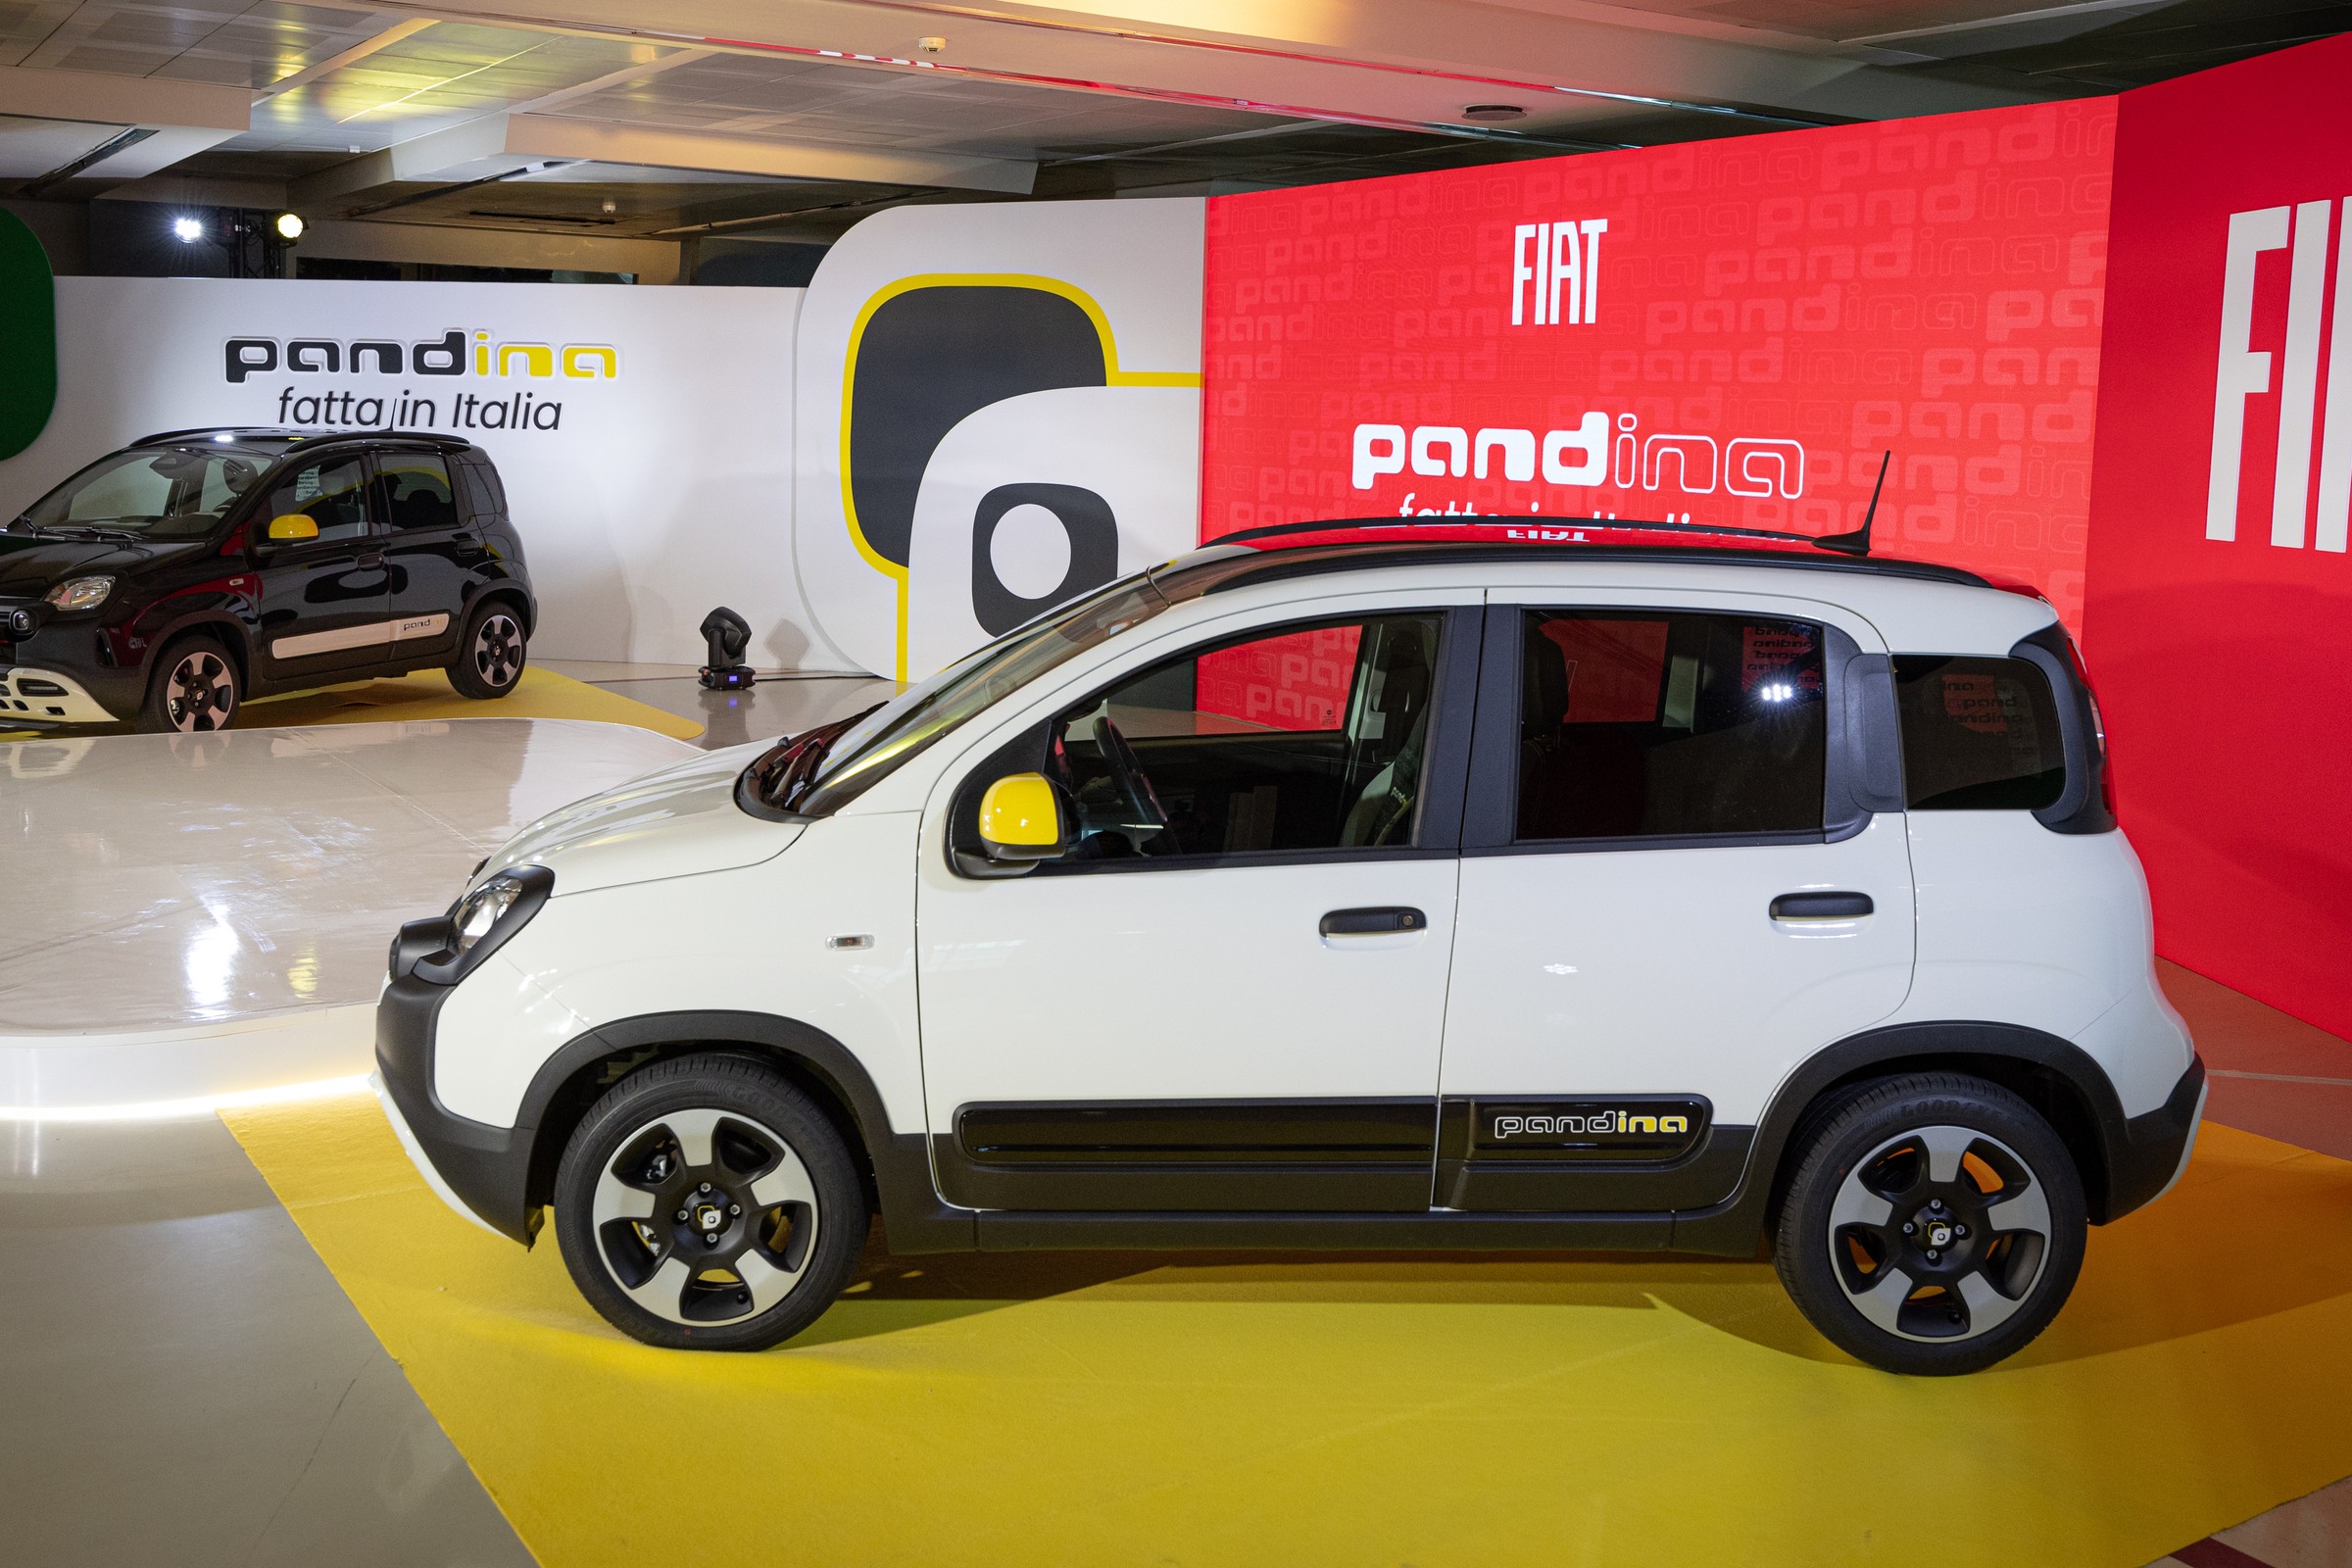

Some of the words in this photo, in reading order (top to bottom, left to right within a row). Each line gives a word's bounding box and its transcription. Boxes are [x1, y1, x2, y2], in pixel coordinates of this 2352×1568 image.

[1300, 172, 1518, 234] pandina
[1522, 141, 1812, 215] pandina
[1265, 218, 1470, 274] pandina
[1477, 196, 1750, 262] pdina
[1235, 262, 1434, 314] pandina
[1438, 247, 1699, 306] paina
[1703, 225, 2058, 296] pandina
[1512, 219, 1607, 325] FIAT
[1645, 281, 1977, 343] pandina
[224, 328, 618, 383] pandina
[1359, 340, 1592, 388] pandina
[1598, 335, 1912, 392] pandina
[278, 386, 382, 425] fatta
[398, 389, 435, 427] in
[453, 392, 563, 430] Italia
[1320, 382, 1545, 427] pandina
[1352, 412, 1804, 500] pandina
[1494, 1110, 1688, 1139] pandina
